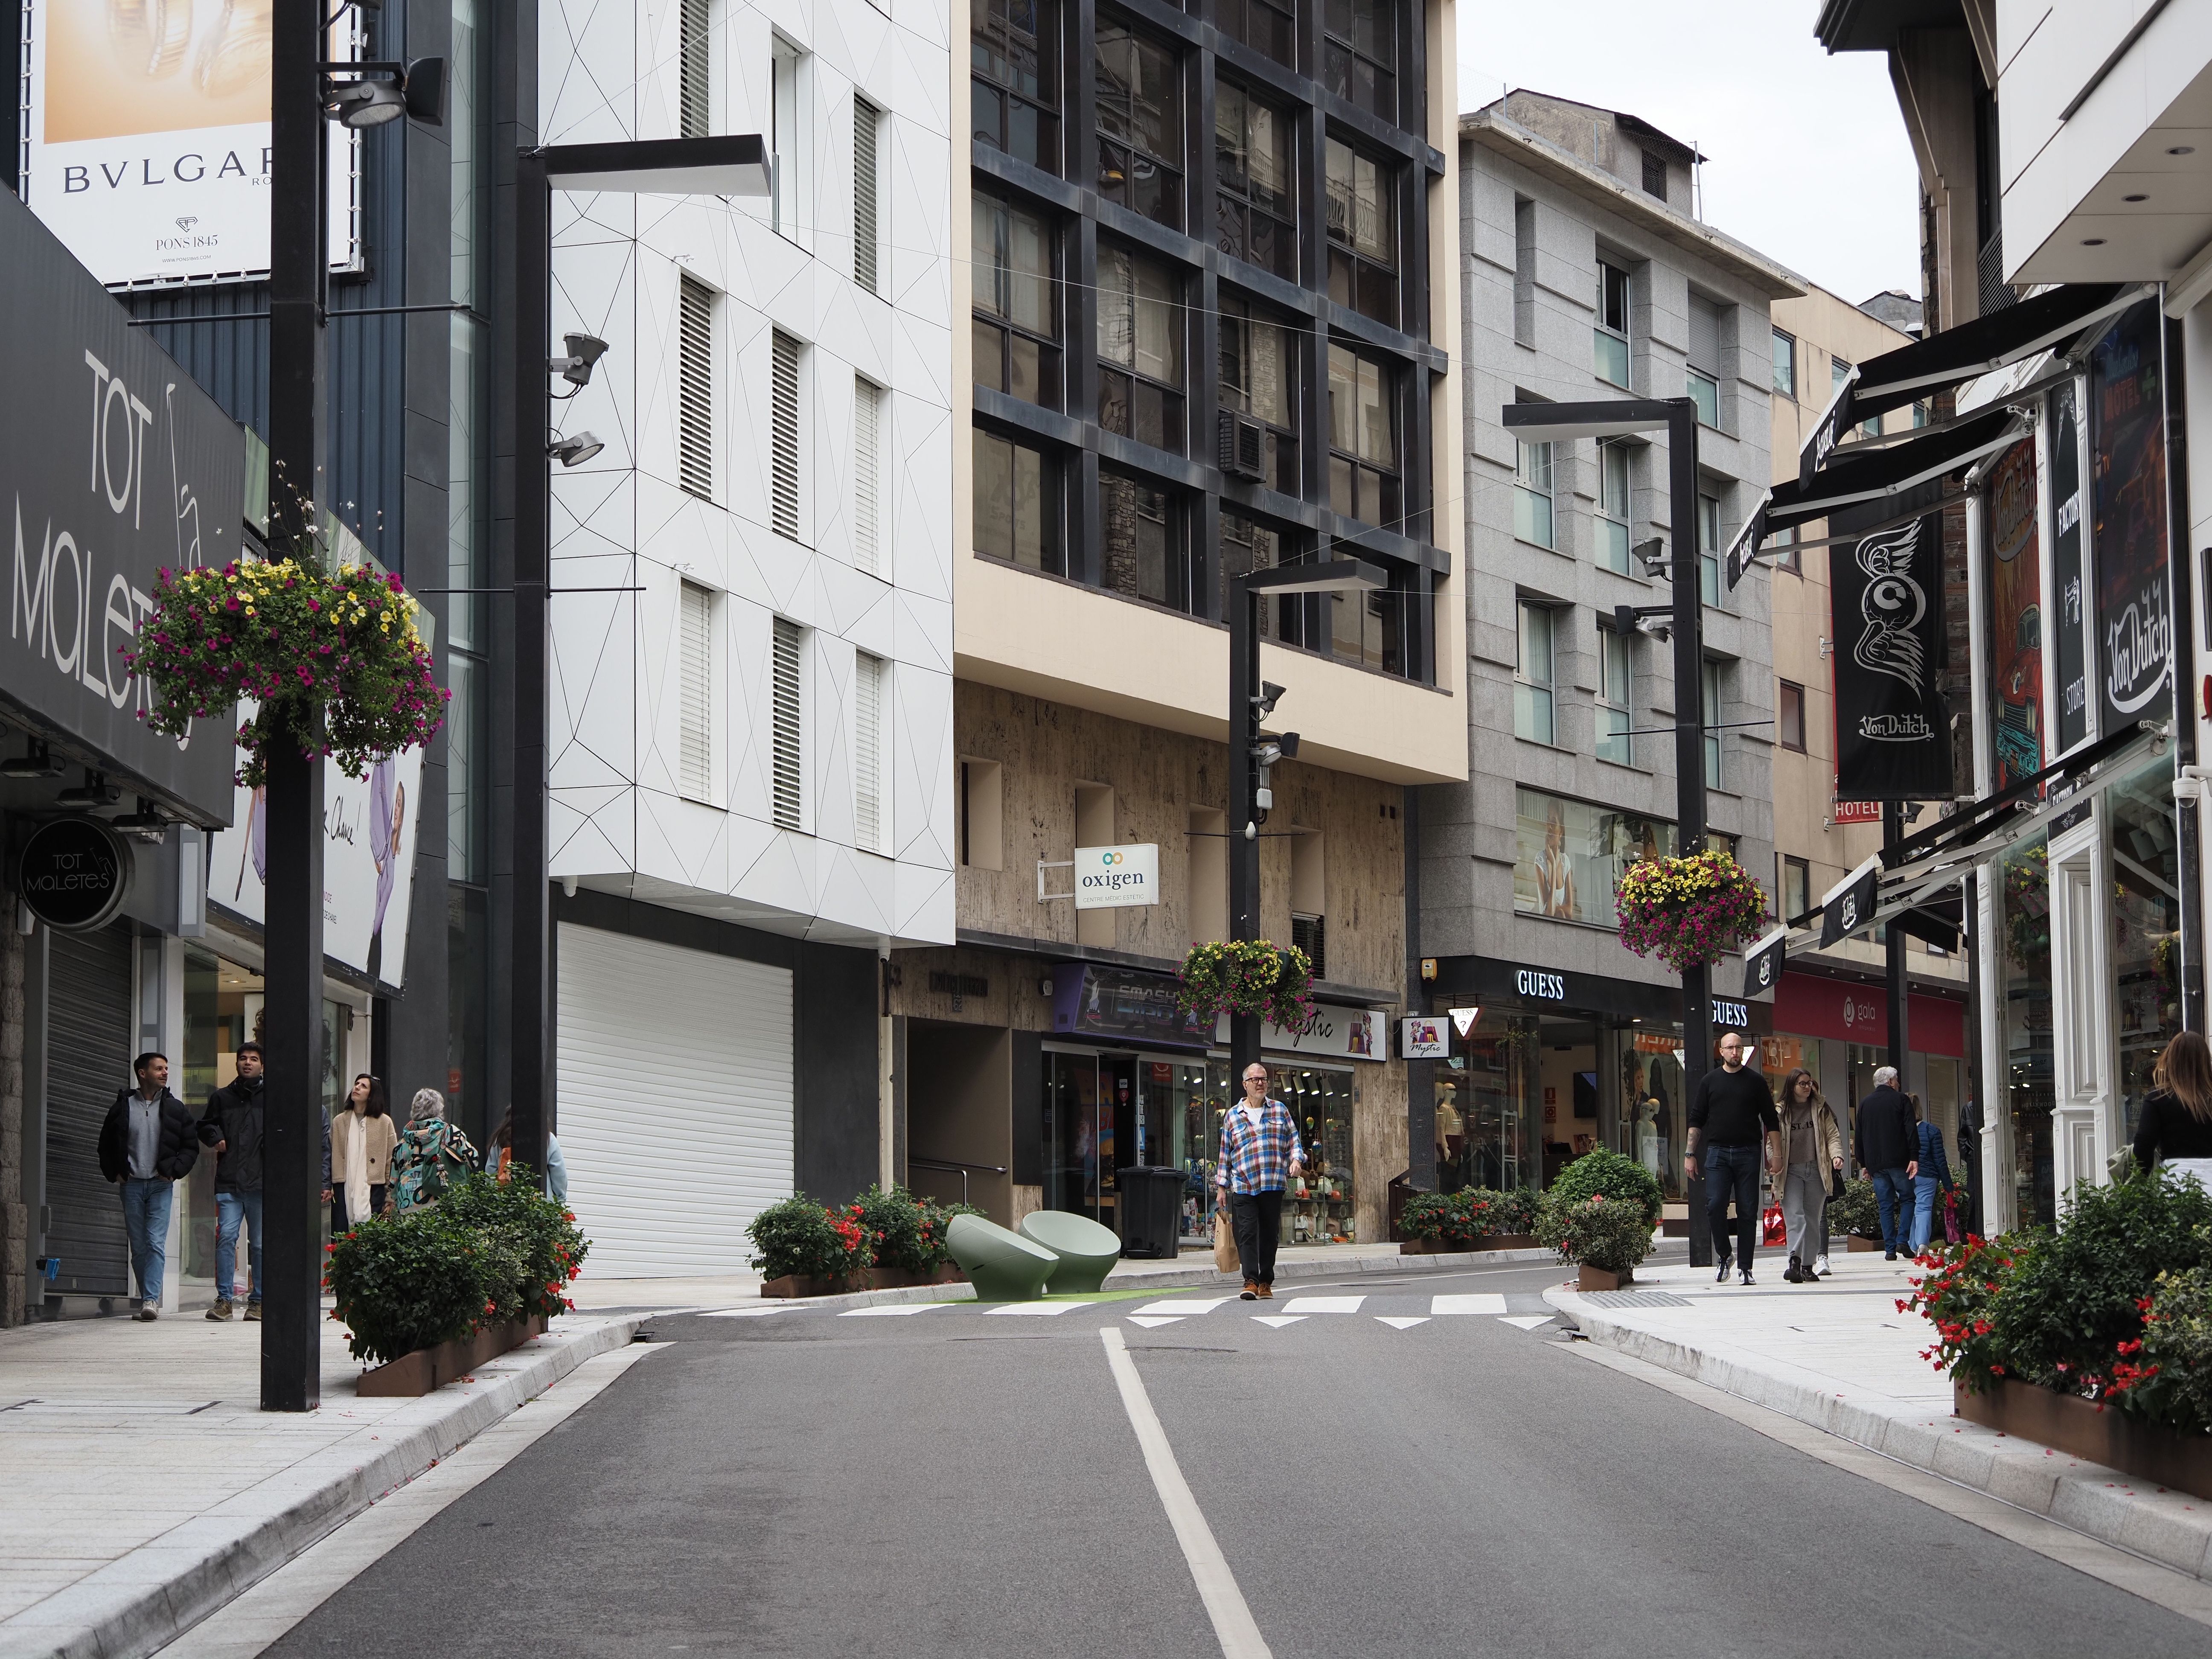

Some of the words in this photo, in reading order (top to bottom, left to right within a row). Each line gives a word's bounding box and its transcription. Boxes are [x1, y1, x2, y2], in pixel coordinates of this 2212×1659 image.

[156, 238, 190, 250] PONS
[194, 234, 218, 247] 1845
[162, 255, 211, 263] WWW.PONS1845.COM
[85, 349, 152, 530] TOT
[2108, 617, 2133, 693] Von
[2129, 577, 2173, 681] Dutch
[2067, 676, 2085, 715] STORE
[1859, 715, 1887, 736] Von
[1887, 714, 1930, 736] Dutch
[1835, 801, 1878, 816] HOTEL
[52, 854, 83, 869] TOT
[1083, 870, 1144, 890] oxigen
[1119, 985, 1176, 1004] SMASH
[1517, 970, 1563, 1000] GUESS
[1858, 1001, 1875, 1022] gala
[1293, 1007, 1333, 1048] ystic
[1410, 1043, 1441, 1057] Mystic
